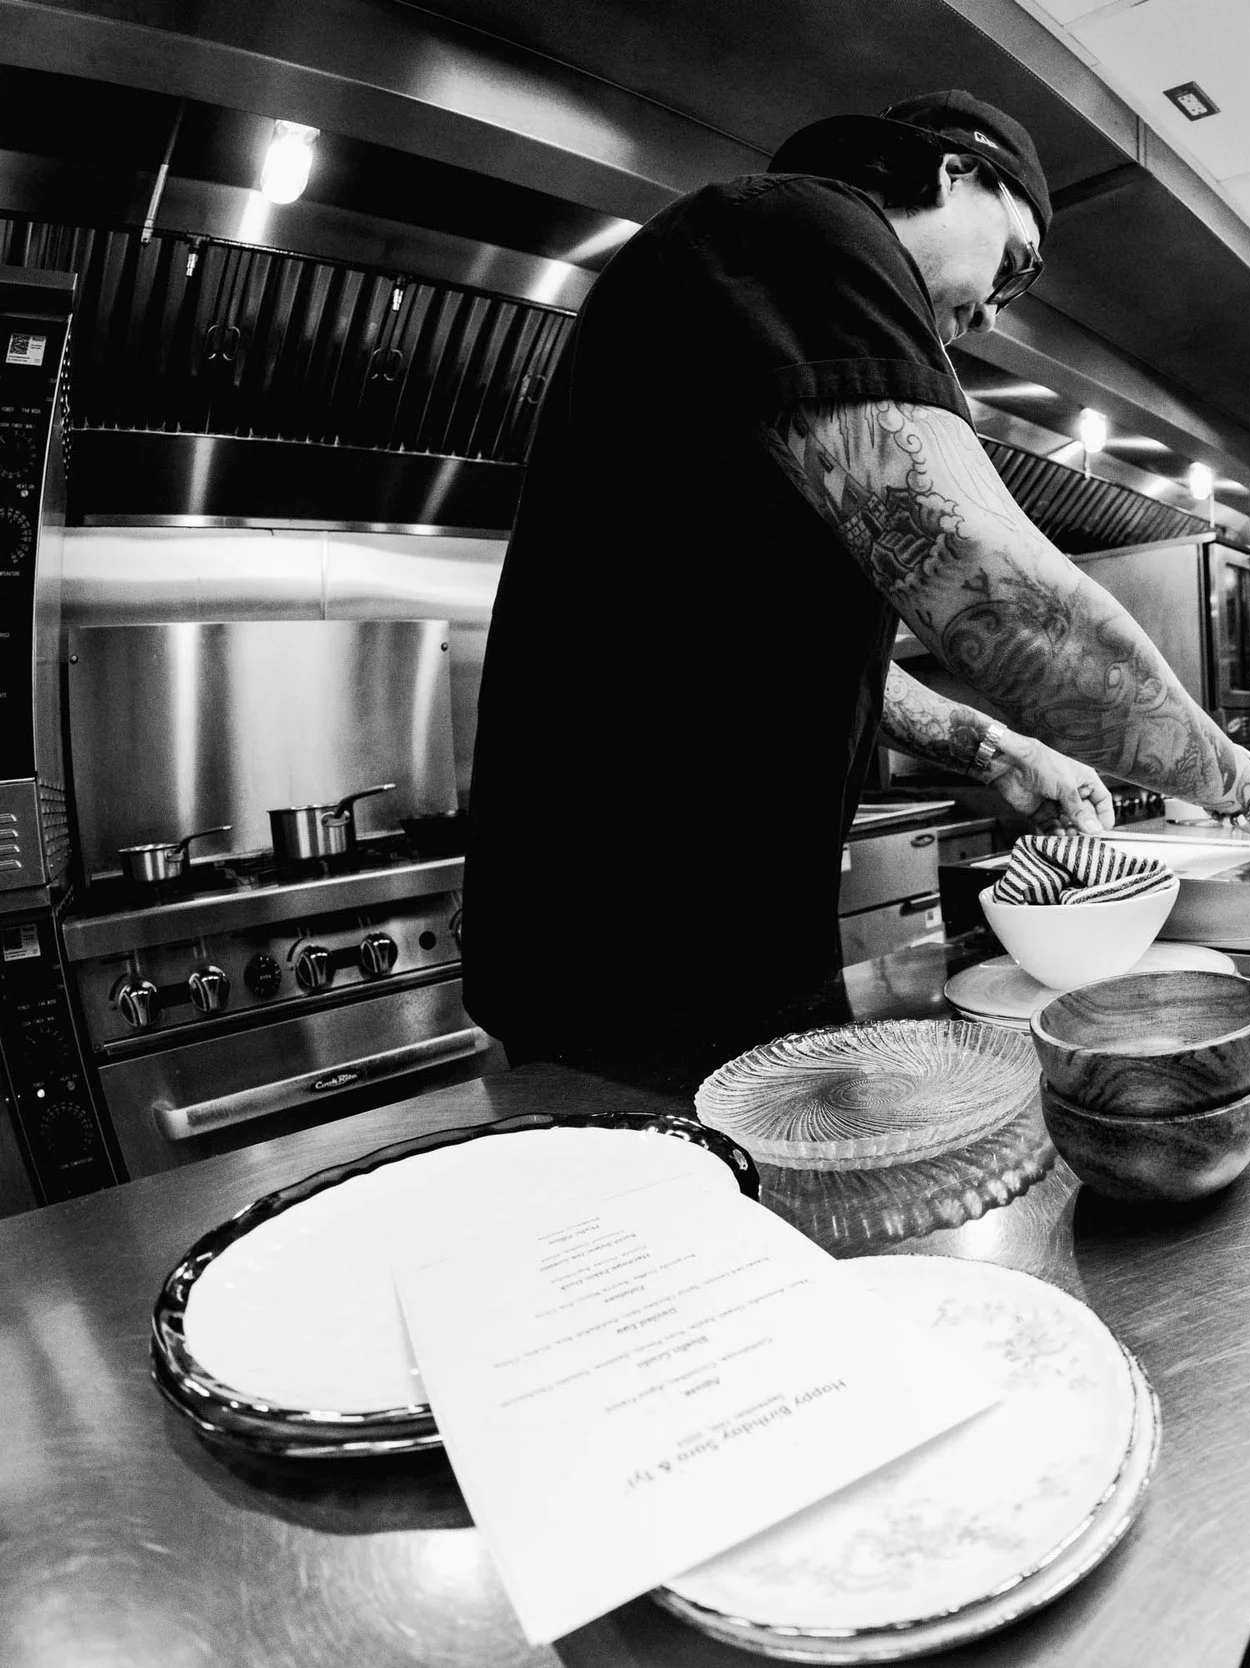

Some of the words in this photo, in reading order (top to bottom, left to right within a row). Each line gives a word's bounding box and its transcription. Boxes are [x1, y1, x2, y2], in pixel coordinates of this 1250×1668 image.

[793, 1379, 846, 1406] Happy
[718, 1404, 792, 1440] Birthday
[675, 1439, 719, 1462] Sara
[656, 1460, 672, 1473] &
